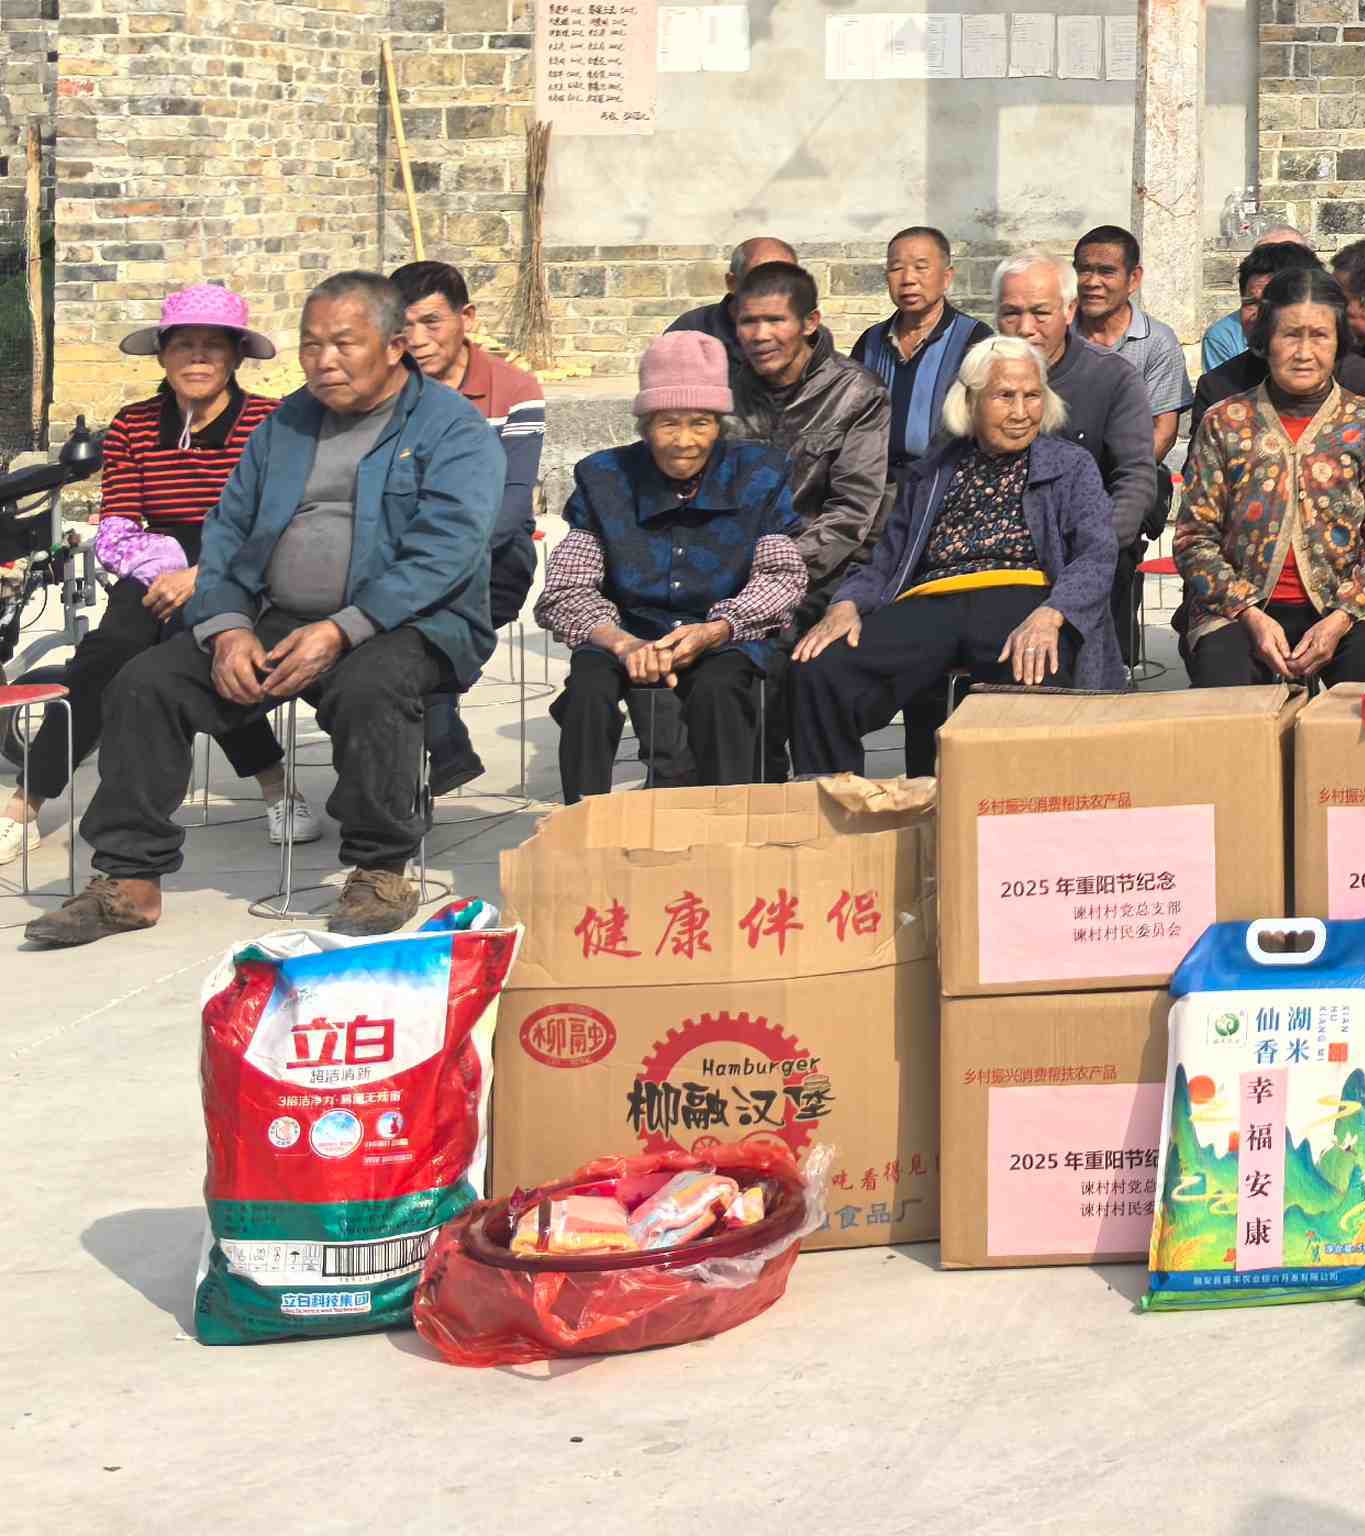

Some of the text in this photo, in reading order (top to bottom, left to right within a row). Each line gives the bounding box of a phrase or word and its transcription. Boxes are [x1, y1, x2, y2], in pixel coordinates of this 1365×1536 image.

[1001, 871, 1176, 898] 2025 年重阳节纪念
[574, 888, 882, 960] 健康伴侣
[533, 1018, 605, 1056] 柳融
[1256, 1006, 1312, 1032] 仙湖
[286, 1015, 395, 1070] 立白
[1254, 1038, 1310, 1064] 香米
[702, 1056, 820, 1077] Hamburger
[627, 1076, 836, 1137] 柳融汉堡
[832, 1152, 939, 1191] 吃看得见
[1009, 1150, 1159, 1171] 2025 年重阳节纪
[1244, 1076, 1274, 1246] 幸福安康
